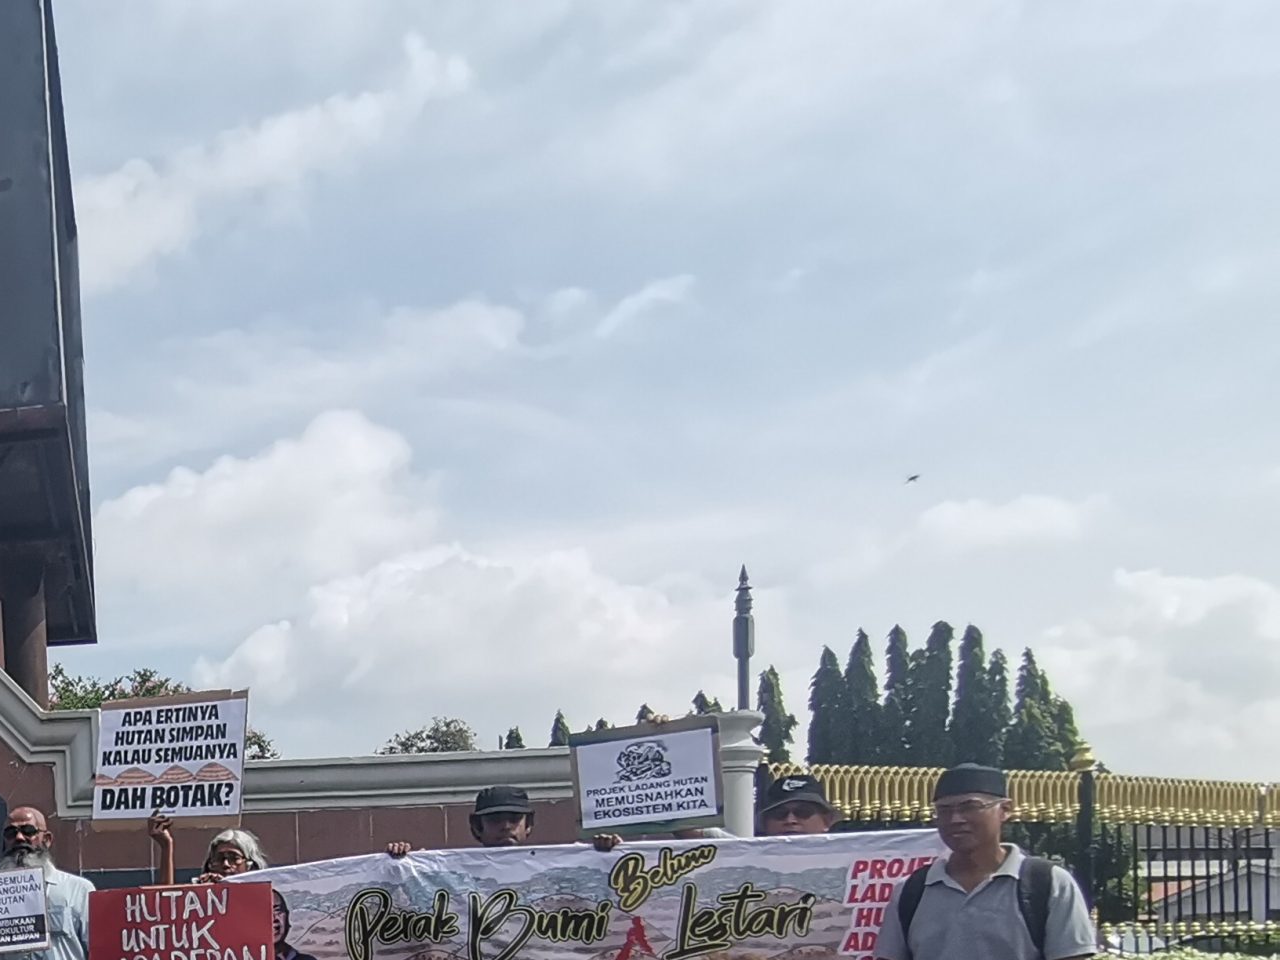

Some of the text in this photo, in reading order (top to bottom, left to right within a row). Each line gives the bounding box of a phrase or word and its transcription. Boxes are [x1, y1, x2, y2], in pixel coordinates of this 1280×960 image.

[122, 704, 219, 727] APA ERTINYA
[114, 723, 227, 746] HUTAN SIMPAN
[102, 743, 237, 766] KALAU SEMUANYA
[101, 782, 234, 811] DAH BOTAK?
[586, 776, 708, 797] PROJEK LADANG HUTAN
[595, 786, 704, 808] MEMUSNAHKAN
[594, 799, 709, 820] EKOSISTEM KITA
[609, 844, 717, 911] Belum
[851, 856, 936, 880] PROJE
[125, 888, 230, 923] HUTAN
[122, 920, 220, 952] UNTUK
